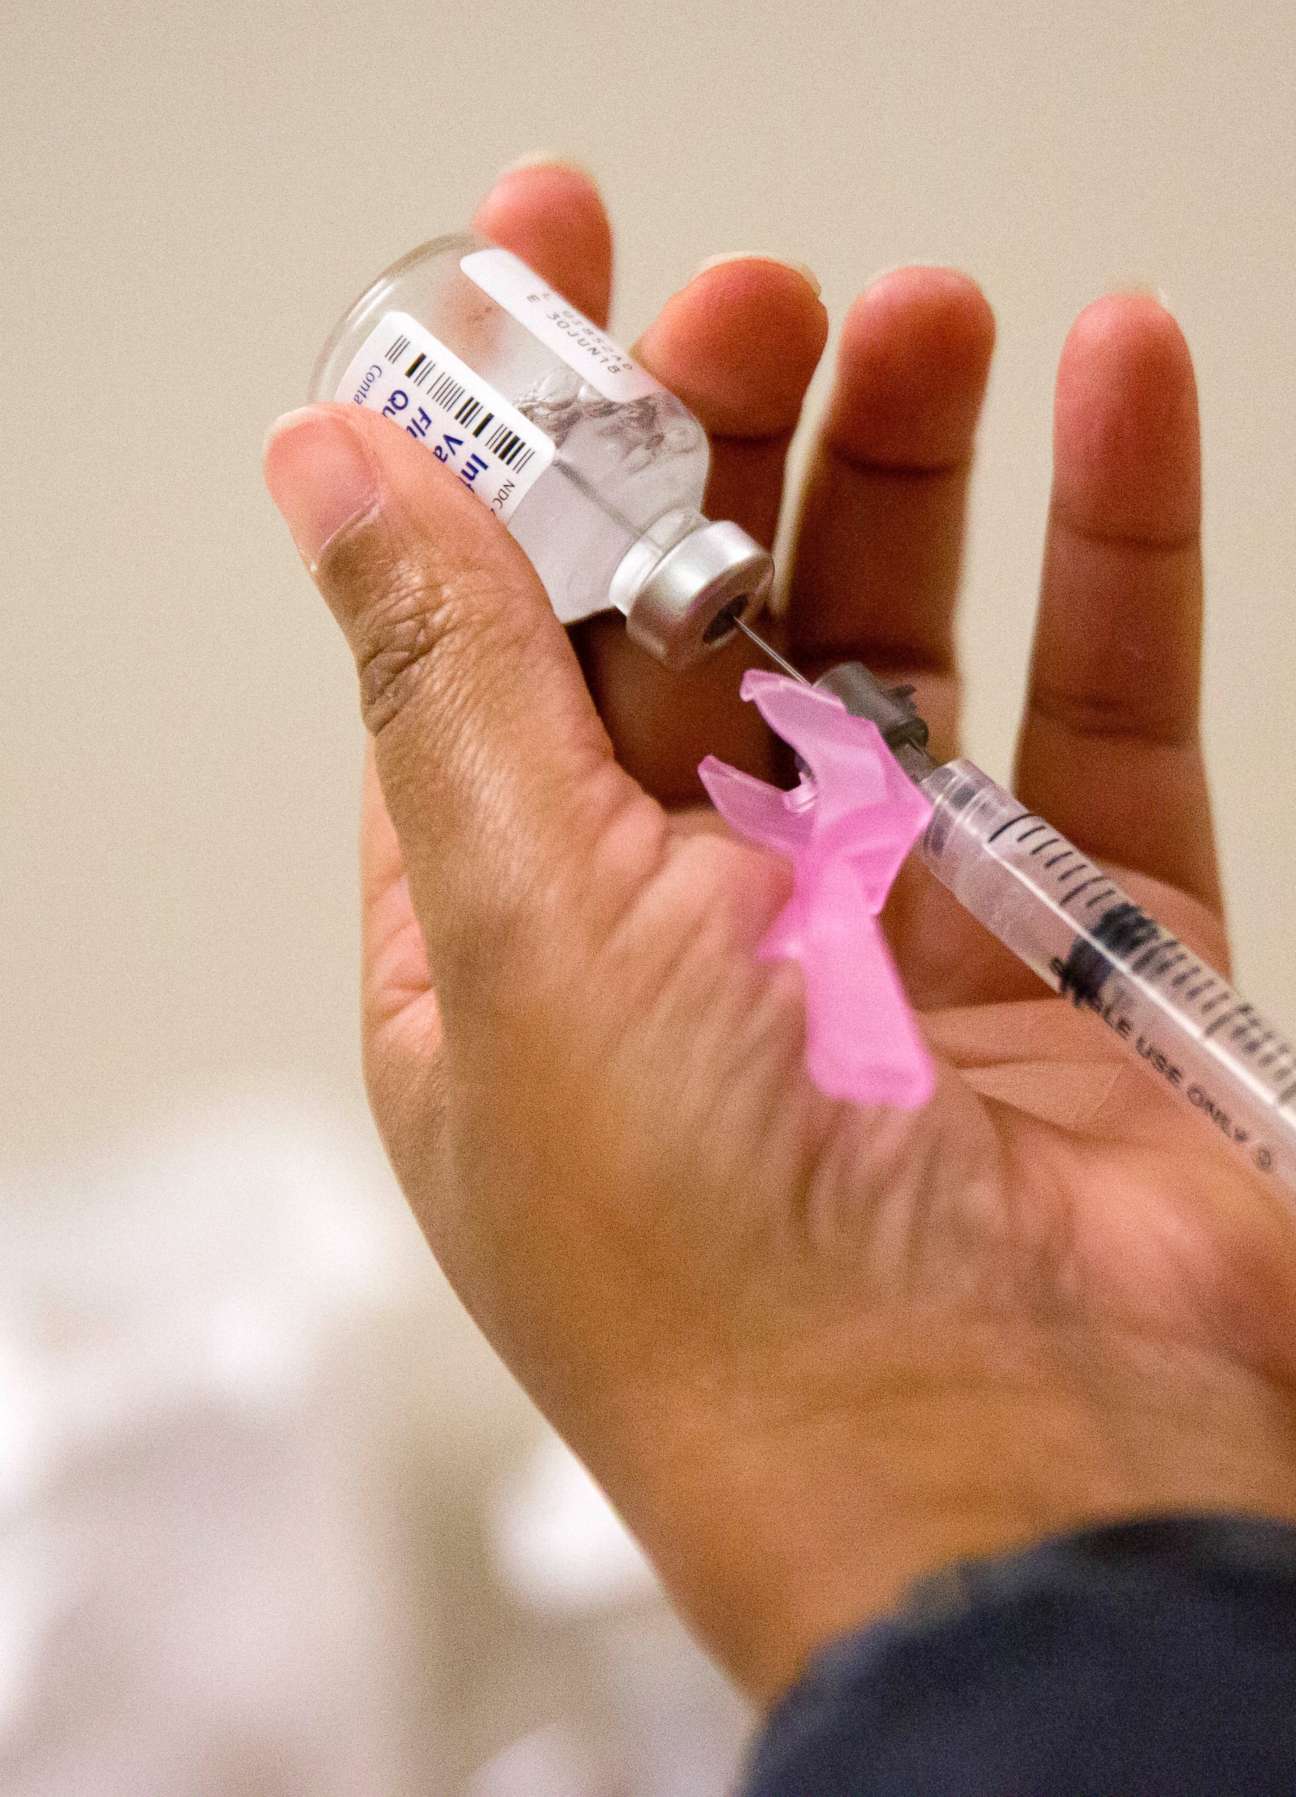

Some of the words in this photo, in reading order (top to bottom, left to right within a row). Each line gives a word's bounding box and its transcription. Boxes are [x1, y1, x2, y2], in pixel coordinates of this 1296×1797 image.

[526, 294, 541, 303] E
[546, 312, 621, 374] 30JUN18
[492, 479, 516, 510] NDC
[1135, 1035, 1184, 1088] USE
